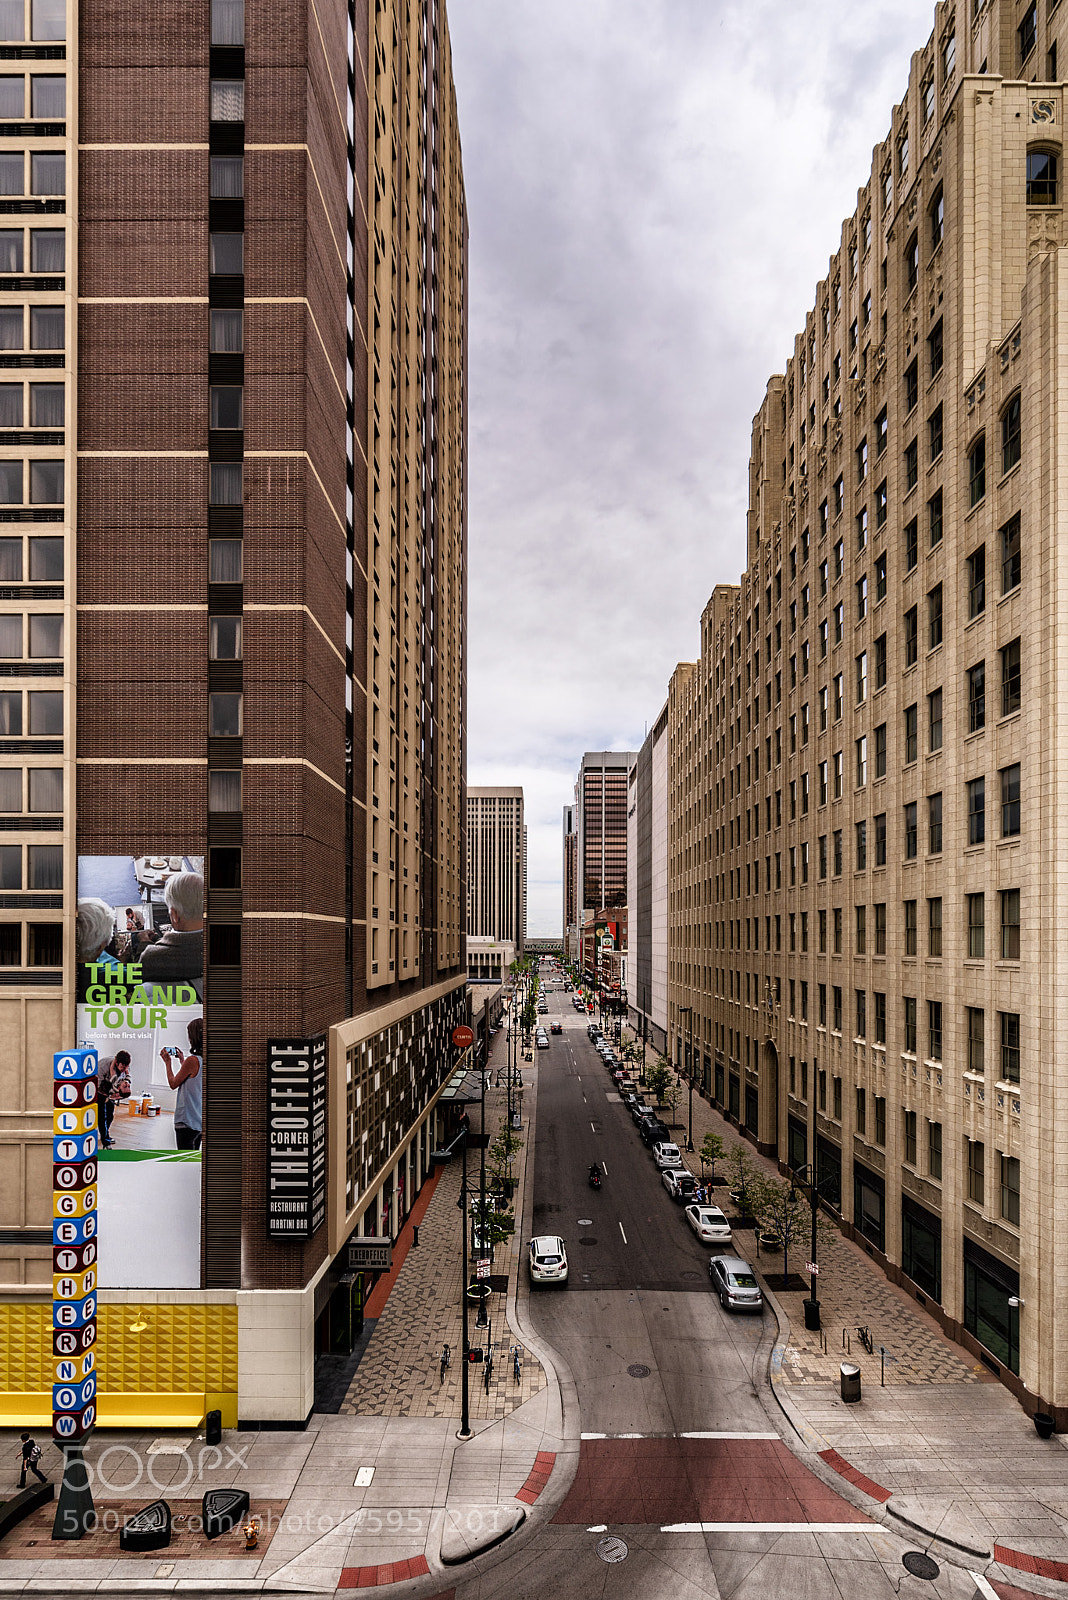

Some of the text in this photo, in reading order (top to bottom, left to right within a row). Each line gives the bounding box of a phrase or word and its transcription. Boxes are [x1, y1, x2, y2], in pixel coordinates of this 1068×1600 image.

[85, 963, 143, 984] THE
[85, 985, 197, 1007] GRAND
[85, 1007, 168, 1029] TOUR
[85, 1031, 153, 1039] before the first visit
[312, 1041, 325, 1127] OFFICE
[270, 1045, 310, 1190] THE CORNER OFFICE
[312, 1137, 325, 1188] THE
[270, 1202, 308, 1213] RESTAURANT
[296, 1218, 308, 1229] BAR
